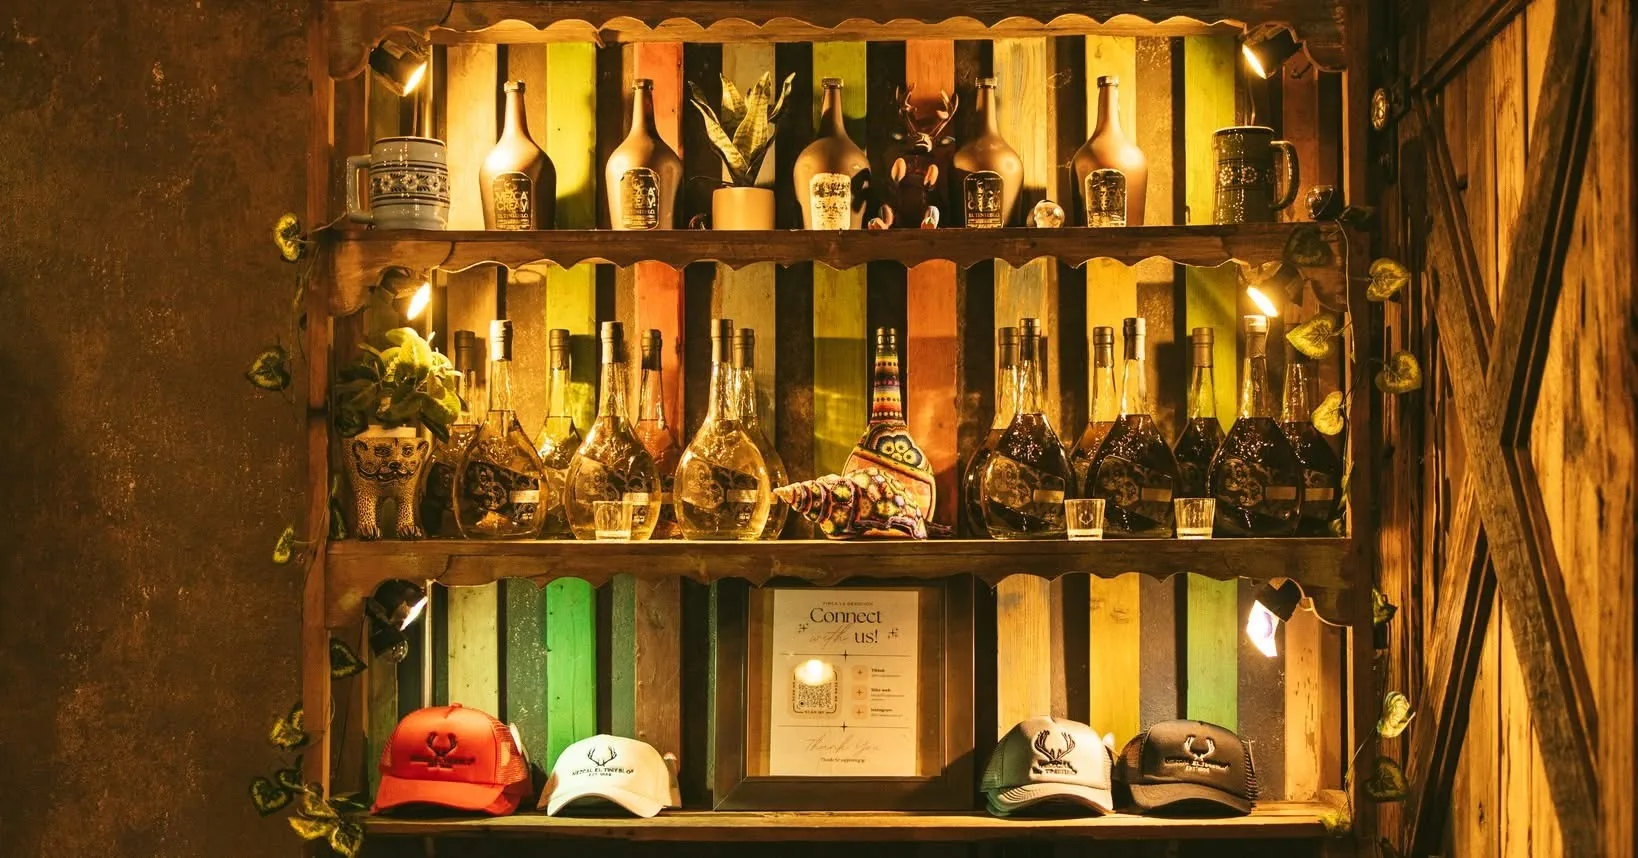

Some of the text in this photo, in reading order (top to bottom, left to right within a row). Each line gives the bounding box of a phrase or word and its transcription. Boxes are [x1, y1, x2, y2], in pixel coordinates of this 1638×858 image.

[810, 607, 883, 624] Connect
[809, 623, 878, 648] with us!
